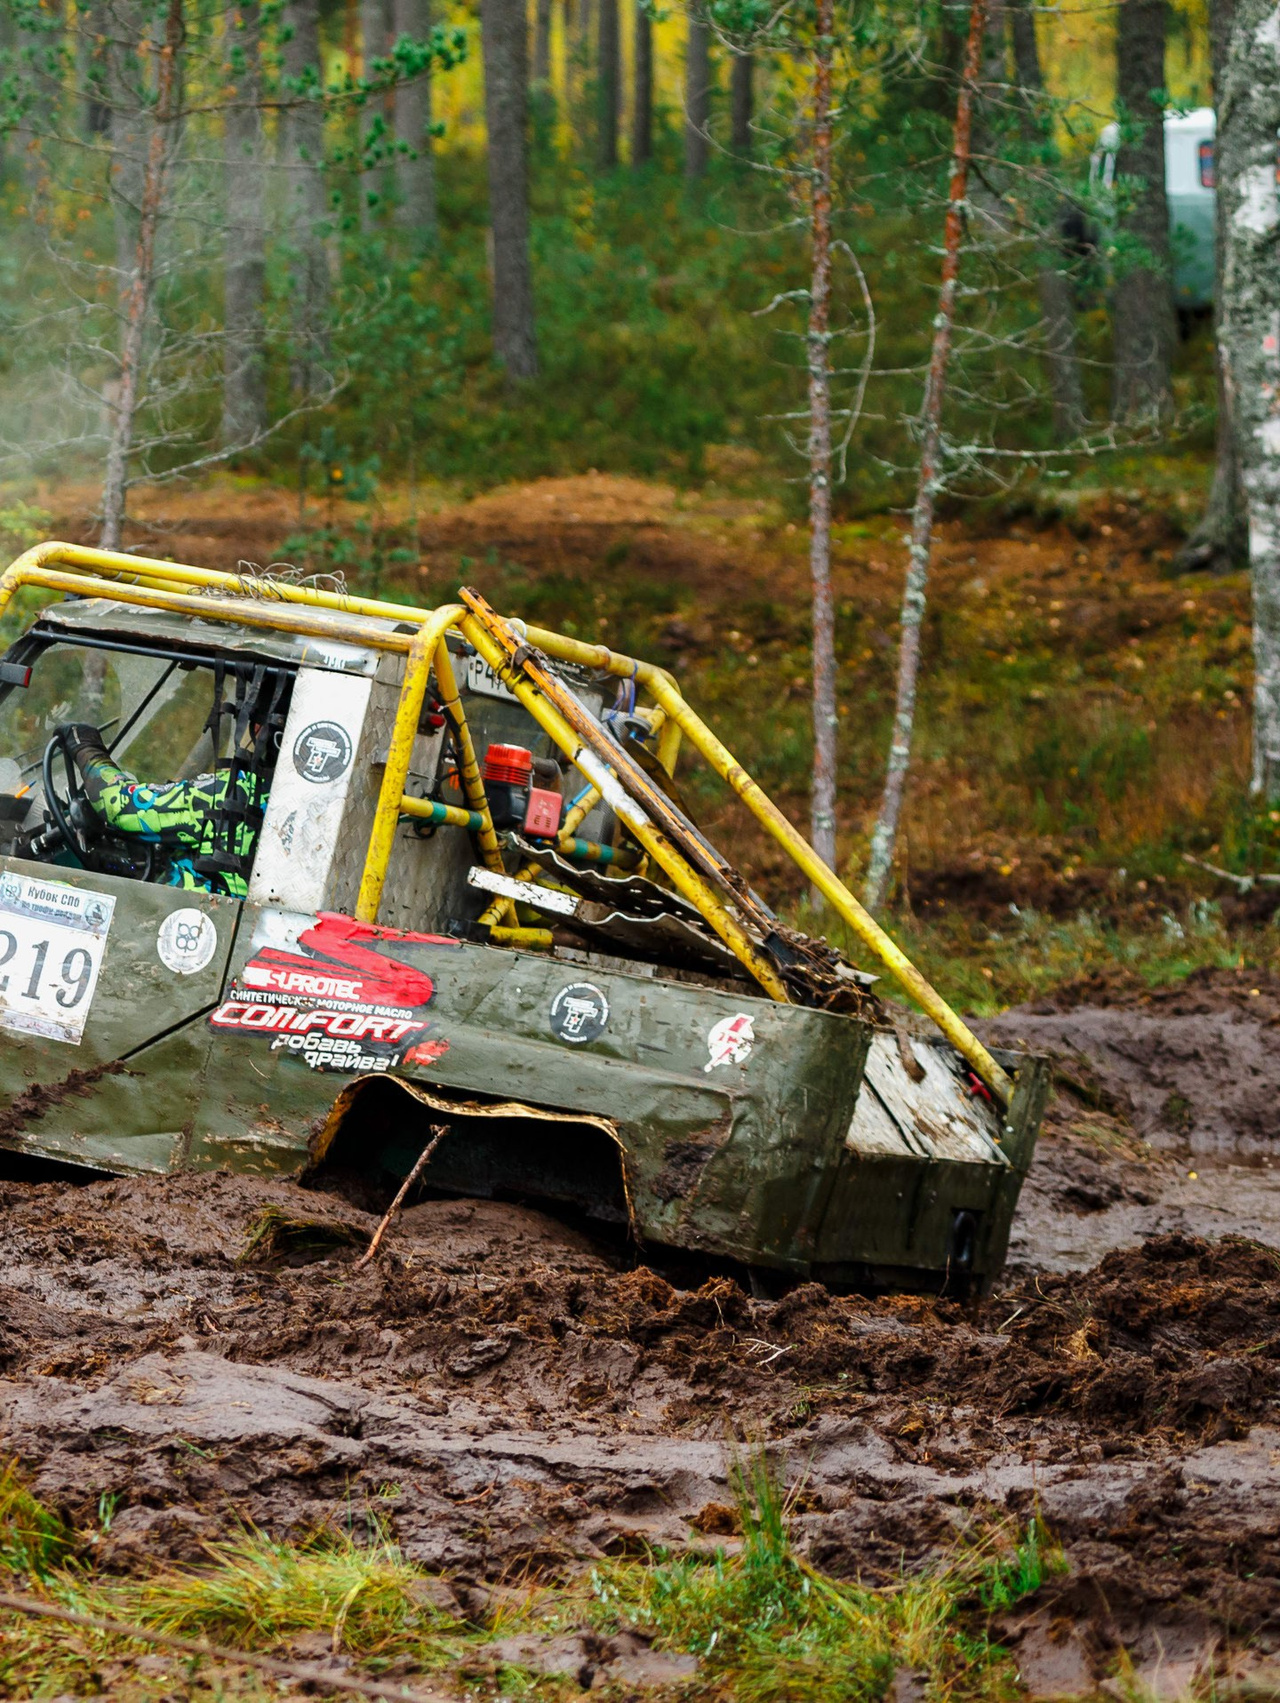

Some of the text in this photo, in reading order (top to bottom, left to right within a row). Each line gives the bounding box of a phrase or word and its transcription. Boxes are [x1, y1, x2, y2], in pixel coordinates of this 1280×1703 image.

[27, 886, 58, 903] Кубок
[317, 999, 375, 1015] МОТОРНОЕ
[375, 1006, 413, 1020] МАСЛО
